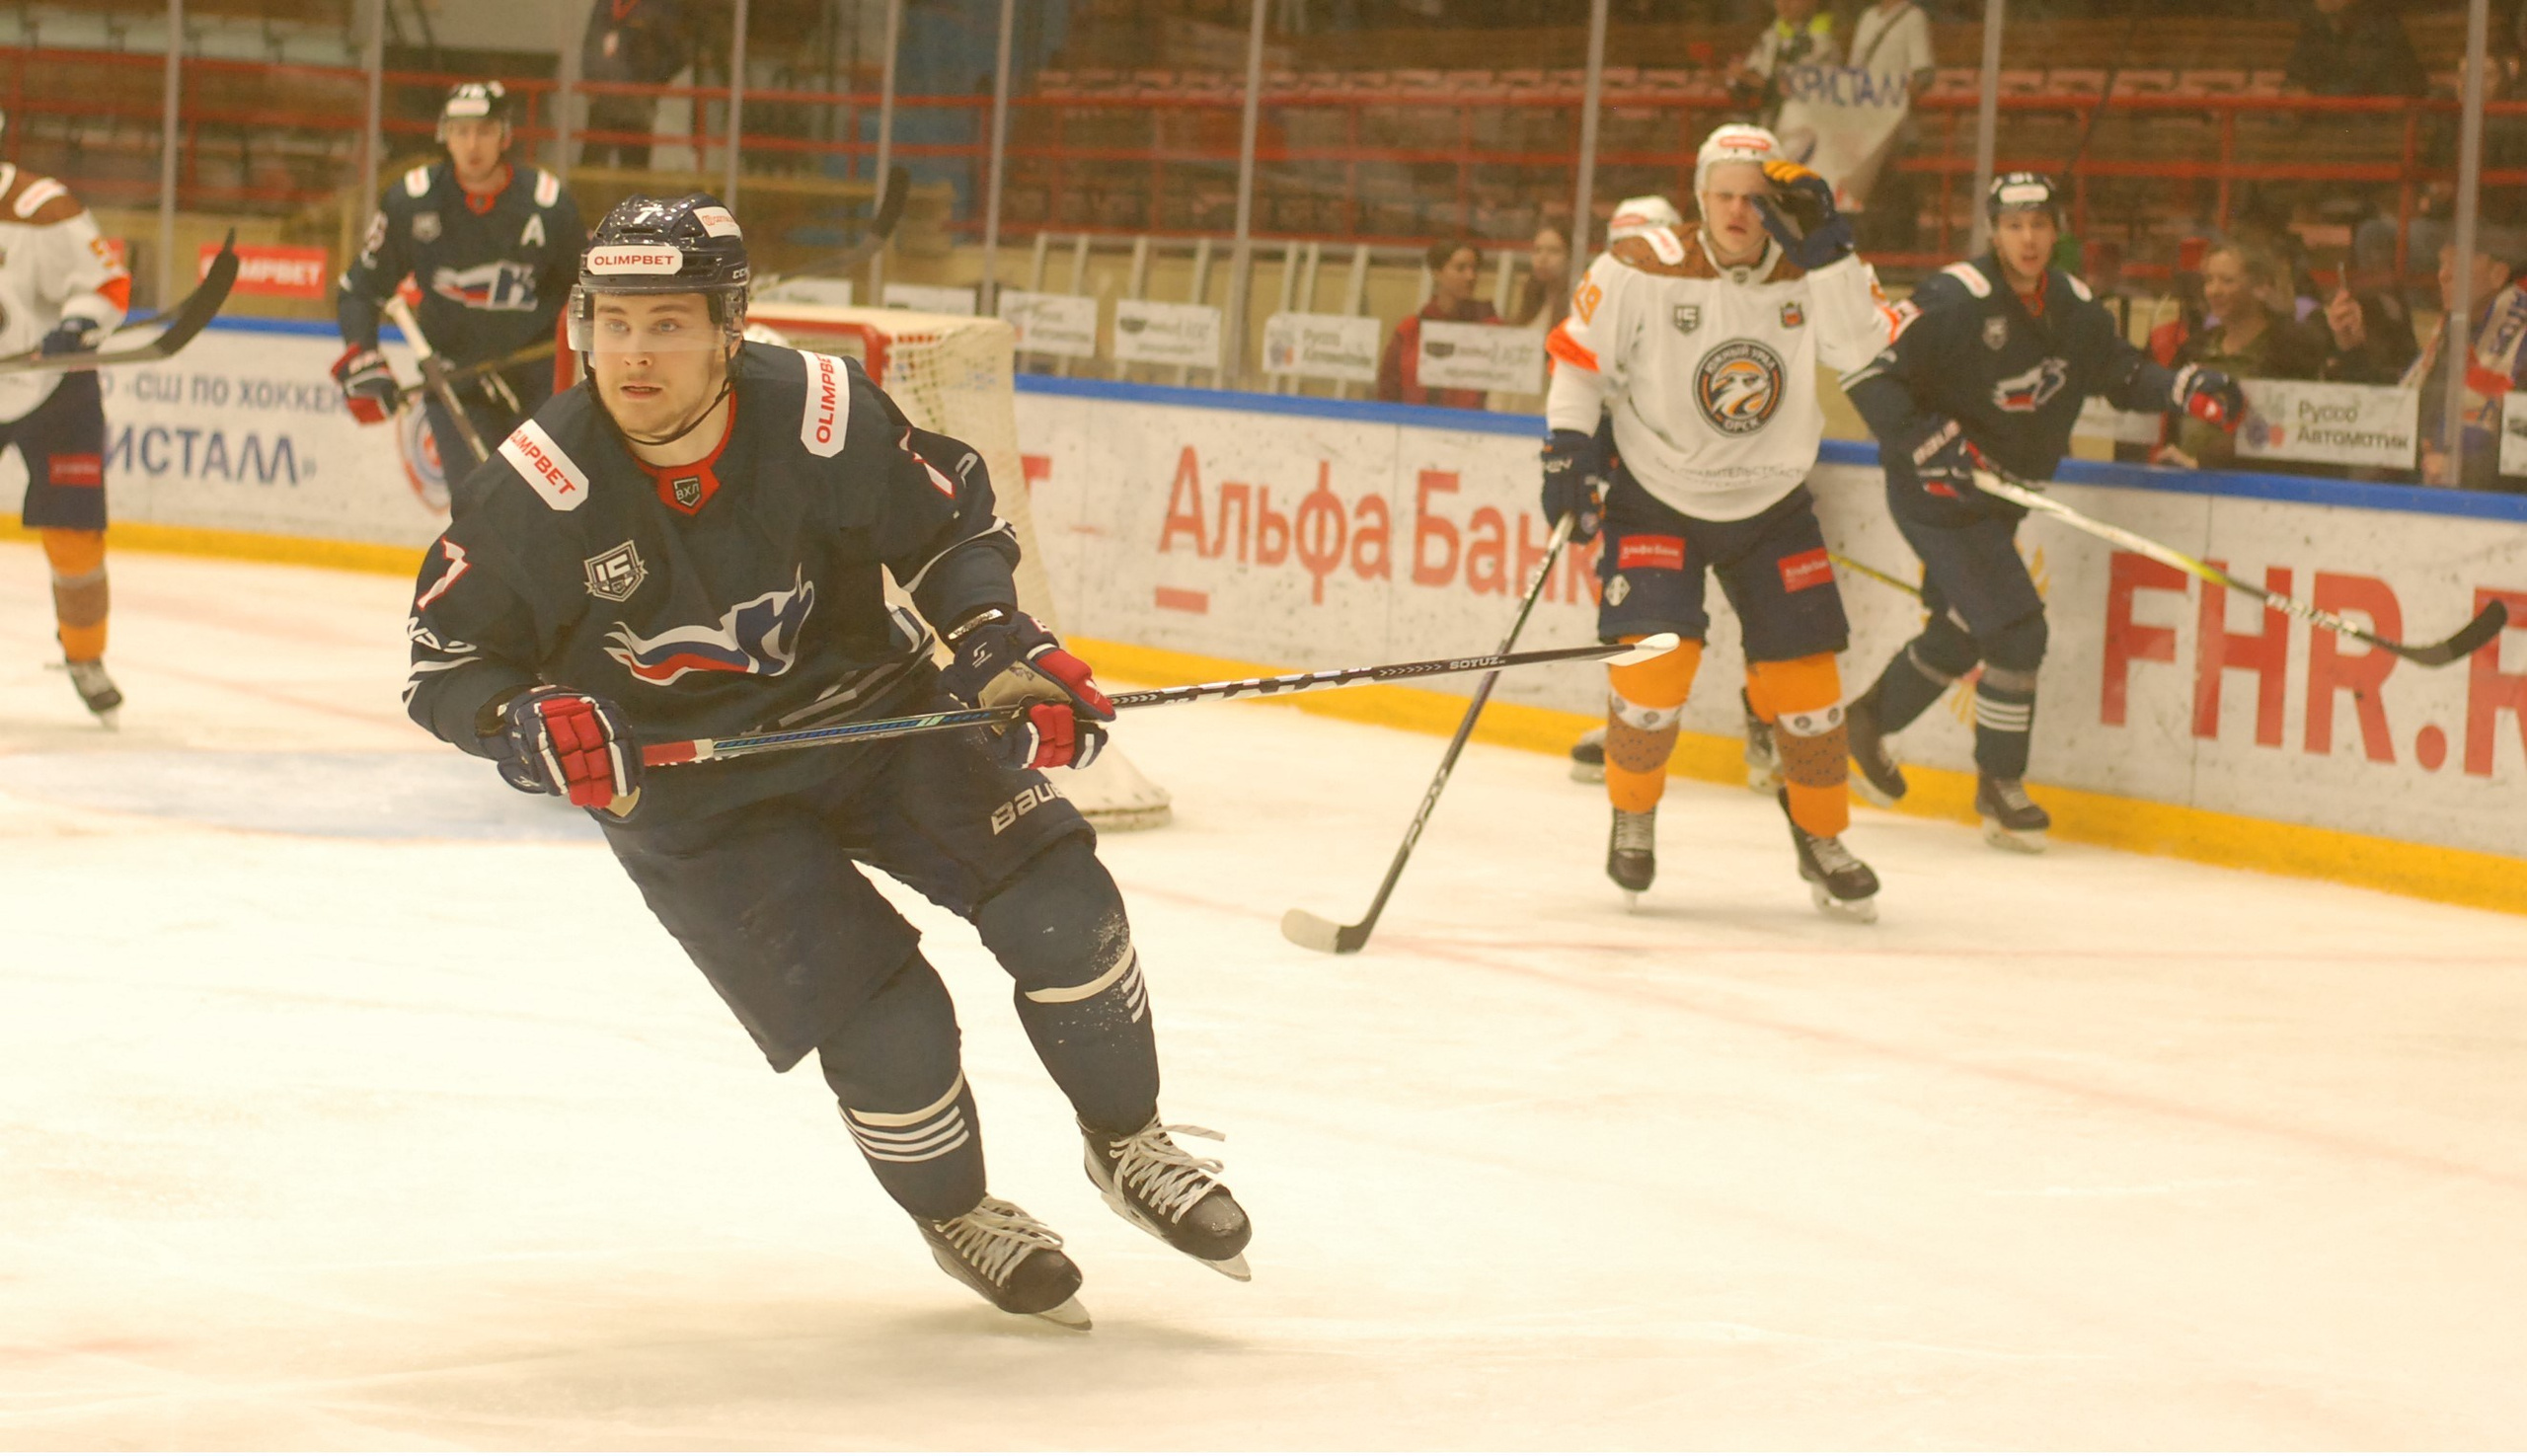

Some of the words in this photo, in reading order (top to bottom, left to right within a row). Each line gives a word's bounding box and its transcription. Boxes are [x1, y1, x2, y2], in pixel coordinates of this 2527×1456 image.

[520, 212, 546, 247] A
[593, 255, 675, 267] OLIMPBET
[2298, 399, 2359, 423] Руссо
[104, 424, 317, 487] ИСТАЛЛ»
[675, 482, 700, 501] ВХЛ
[1157, 444, 1393, 606] Альфа
[1412, 469, 1605, 609] Банк
[1449, 656, 1499, 670] SOYUZ
